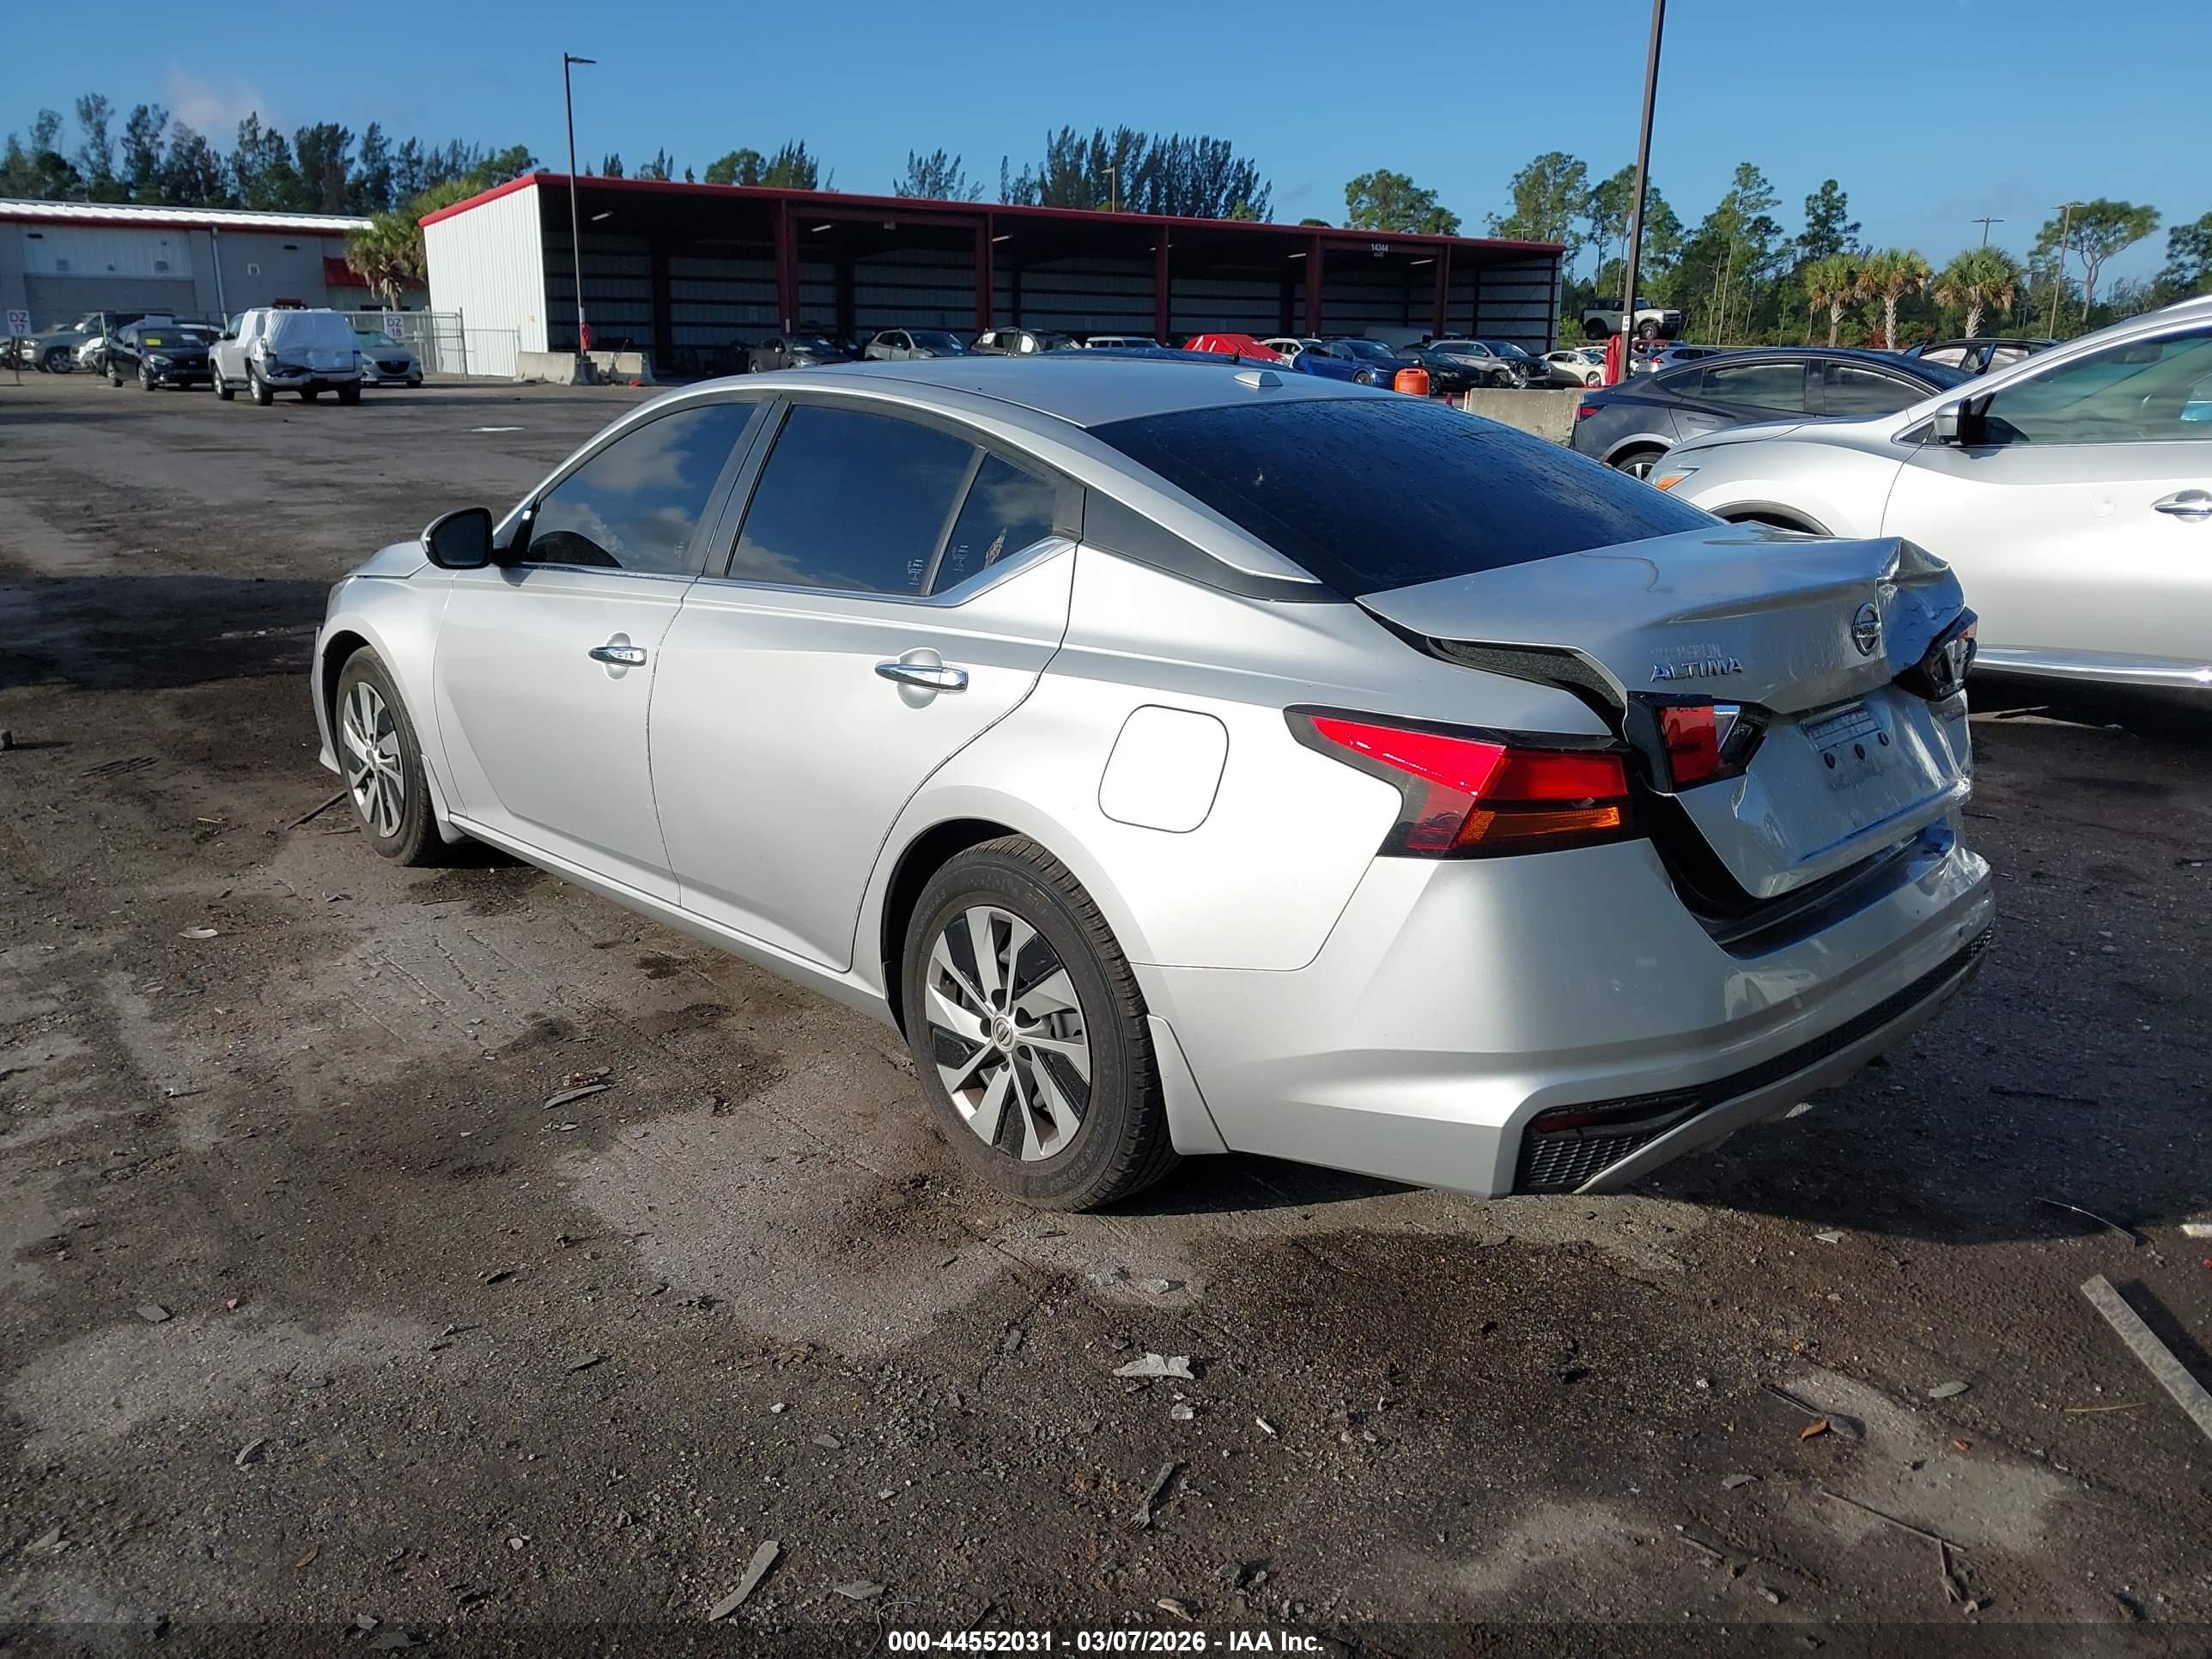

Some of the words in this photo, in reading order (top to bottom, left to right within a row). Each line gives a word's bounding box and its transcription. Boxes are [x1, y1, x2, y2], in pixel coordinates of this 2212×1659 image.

[9, 312, 27, 323] DZ
[387, 318, 402, 327] DZ
[15, 324, 26, 334] 17
[392, 328, 403, 337] 18
[1650, 657, 1743, 682] ALTIMA
